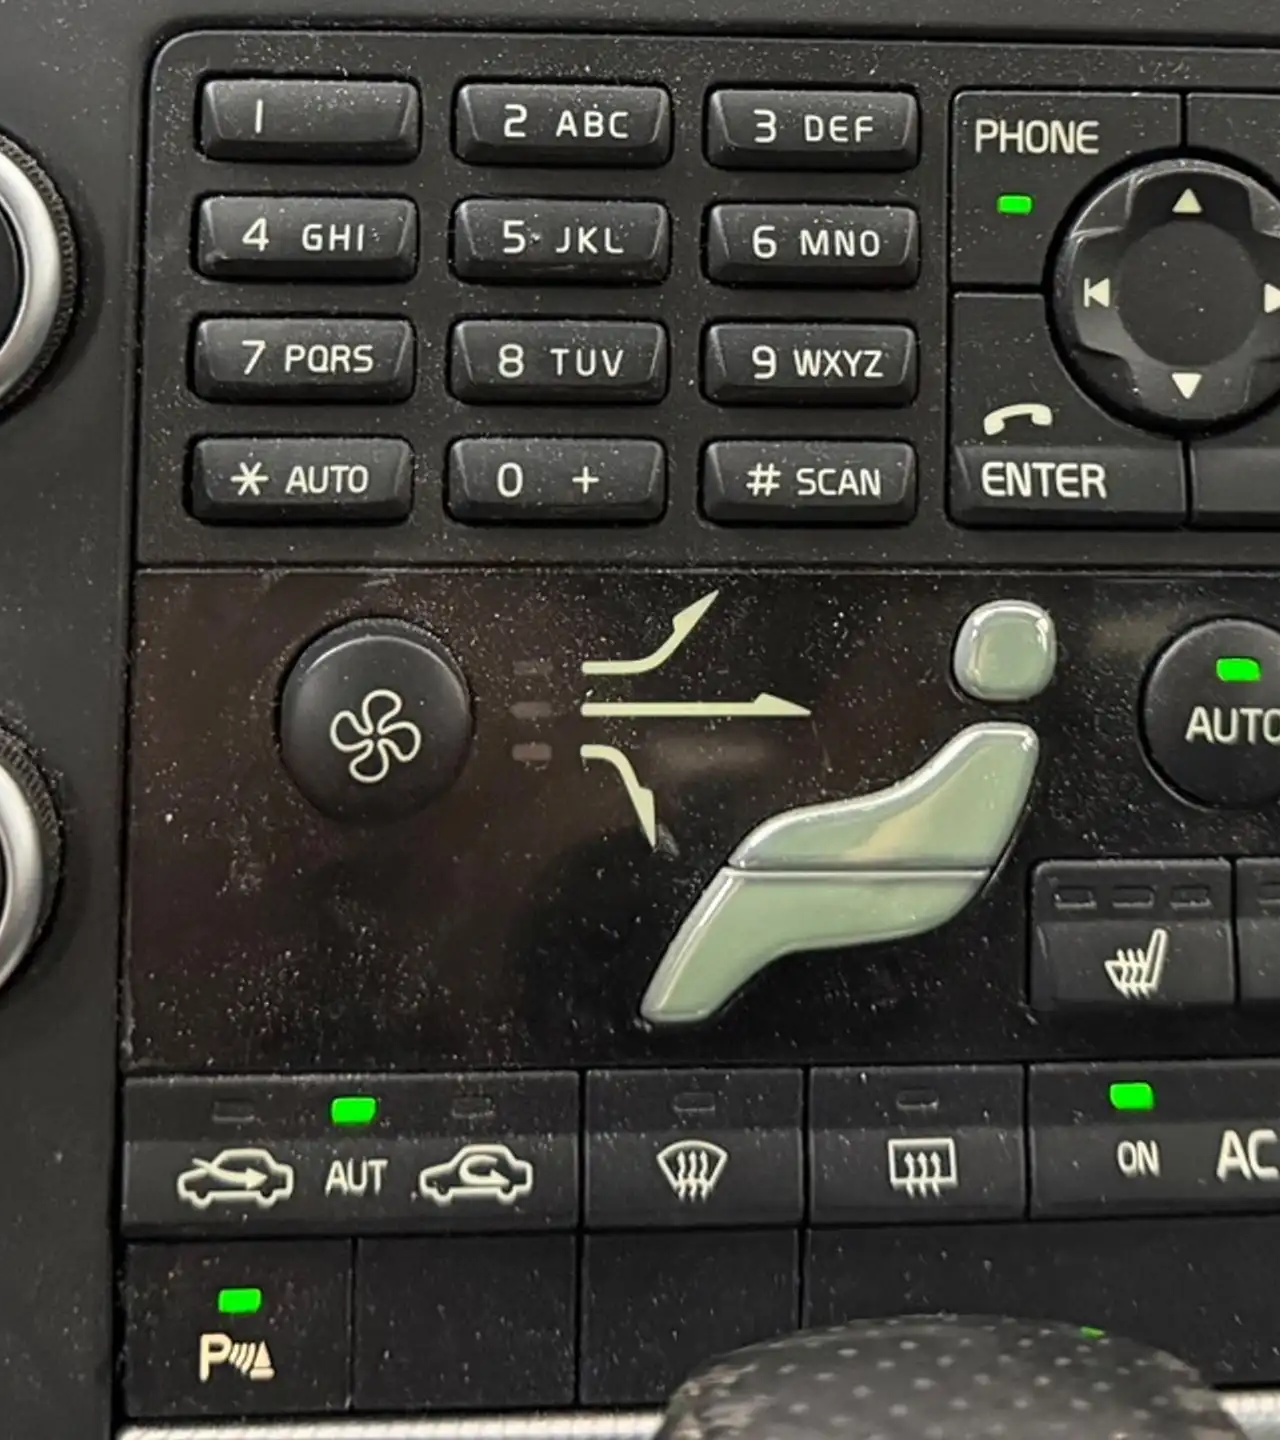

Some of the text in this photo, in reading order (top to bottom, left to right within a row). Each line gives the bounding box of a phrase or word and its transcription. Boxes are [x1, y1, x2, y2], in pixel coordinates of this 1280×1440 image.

[504, 103, 629, 139] 2 ABC
[753, 108, 873, 143] 3 DEF
[975, 119, 1099, 154] PHONE
[242, 217, 365, 252] 4 GHI
[503, 219, 624, 254] 5 JKL
[752, 225, 880, 259] 6 MNO
[241, 339, 374, 375] 7 PQRS
[498, 343, 624, 378] 8 TUV
[752, 345, 883, 379] 9 WXYZ
[285, 465, 369, 494] AUTO
[497, 462, 600, 498] 0 +
[746, 462, 881, 497] # SCAN
[981, 461, 1107, 499] ENTER
[1117, 1140, 1160, 1175] ON
[1217, 1129, 1279, 1179] AC
[325, 1158, 388, 1194] AUT
[199, 1333, 233, 1381] P
